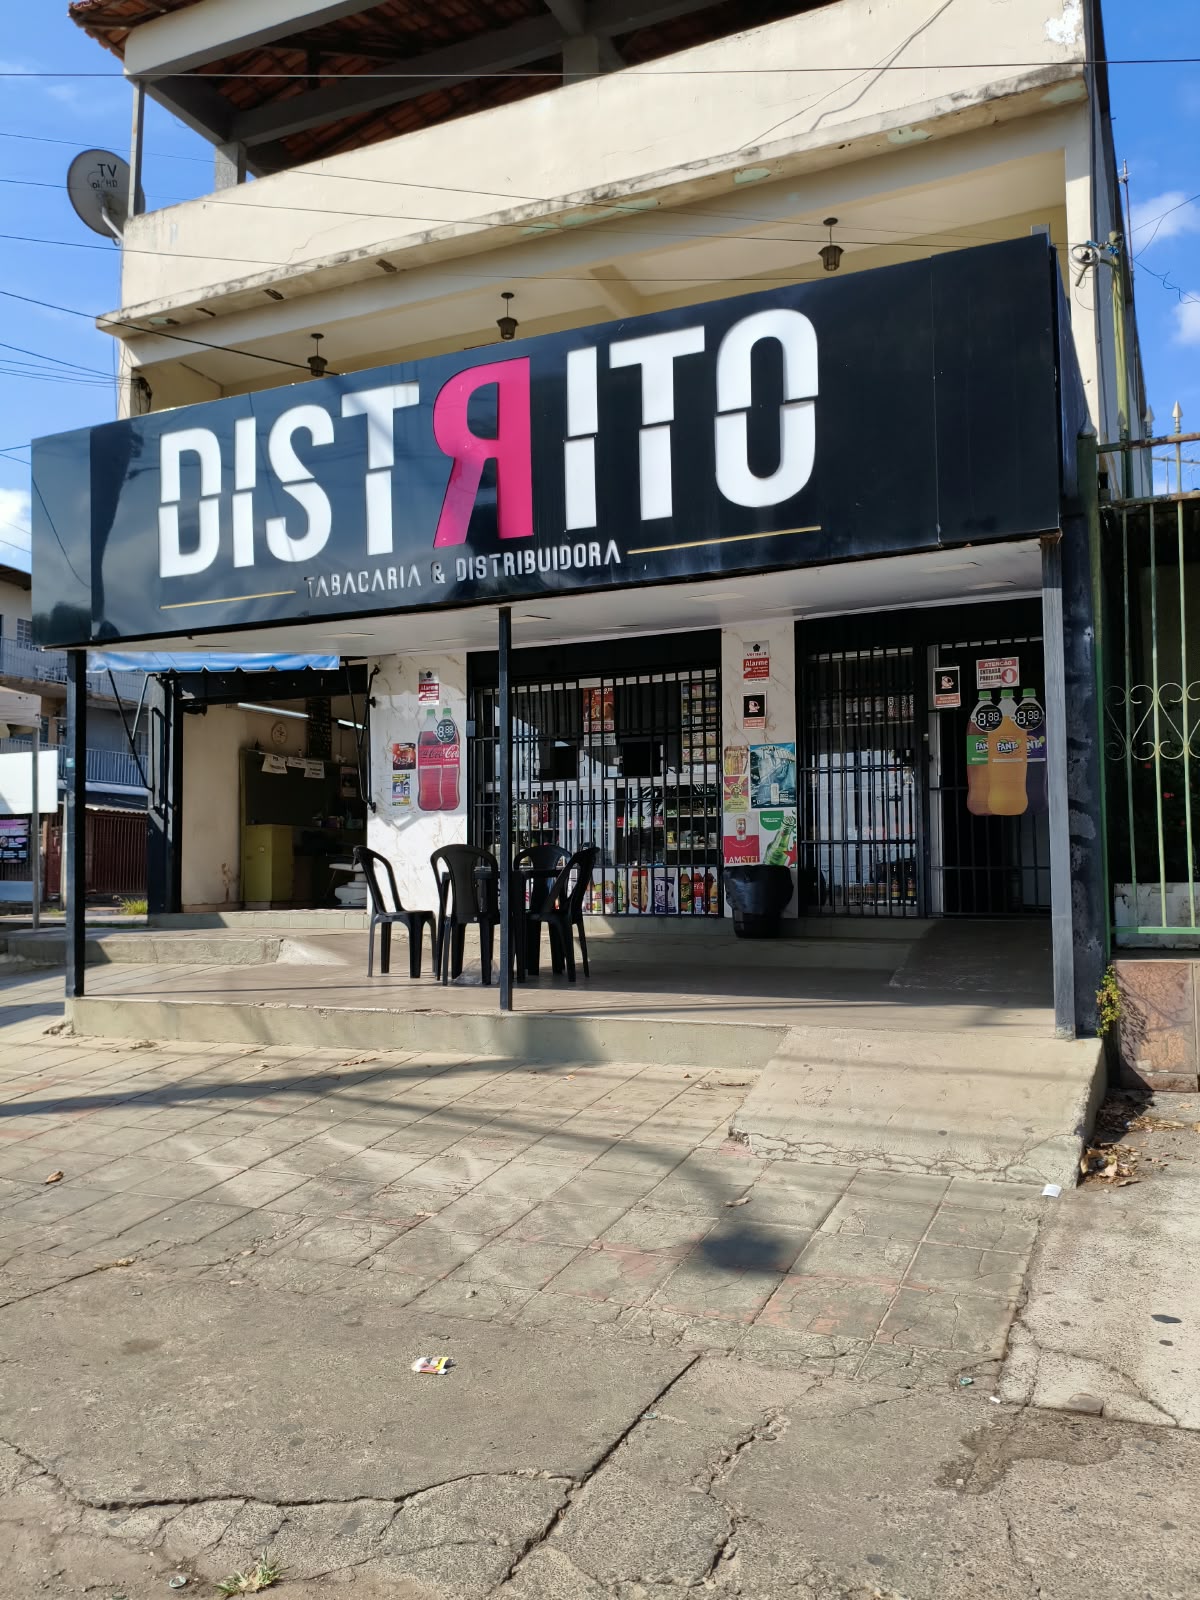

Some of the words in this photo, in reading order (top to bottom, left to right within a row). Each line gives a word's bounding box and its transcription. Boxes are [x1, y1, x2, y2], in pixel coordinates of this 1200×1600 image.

[97, 163, 117, 178] TV
[158, 308, 820, 578] DISTRITO
[304, 564, 422, 599] TABACARIA
[431, 560, 446, 585] &
[456, 539, 622, 583] DISTRIBUIDORA
[975, 742, 989, 750] FAN
[997, 741, 1019, 751] FANTA
[1026, 740, 1043, 749] NTA
